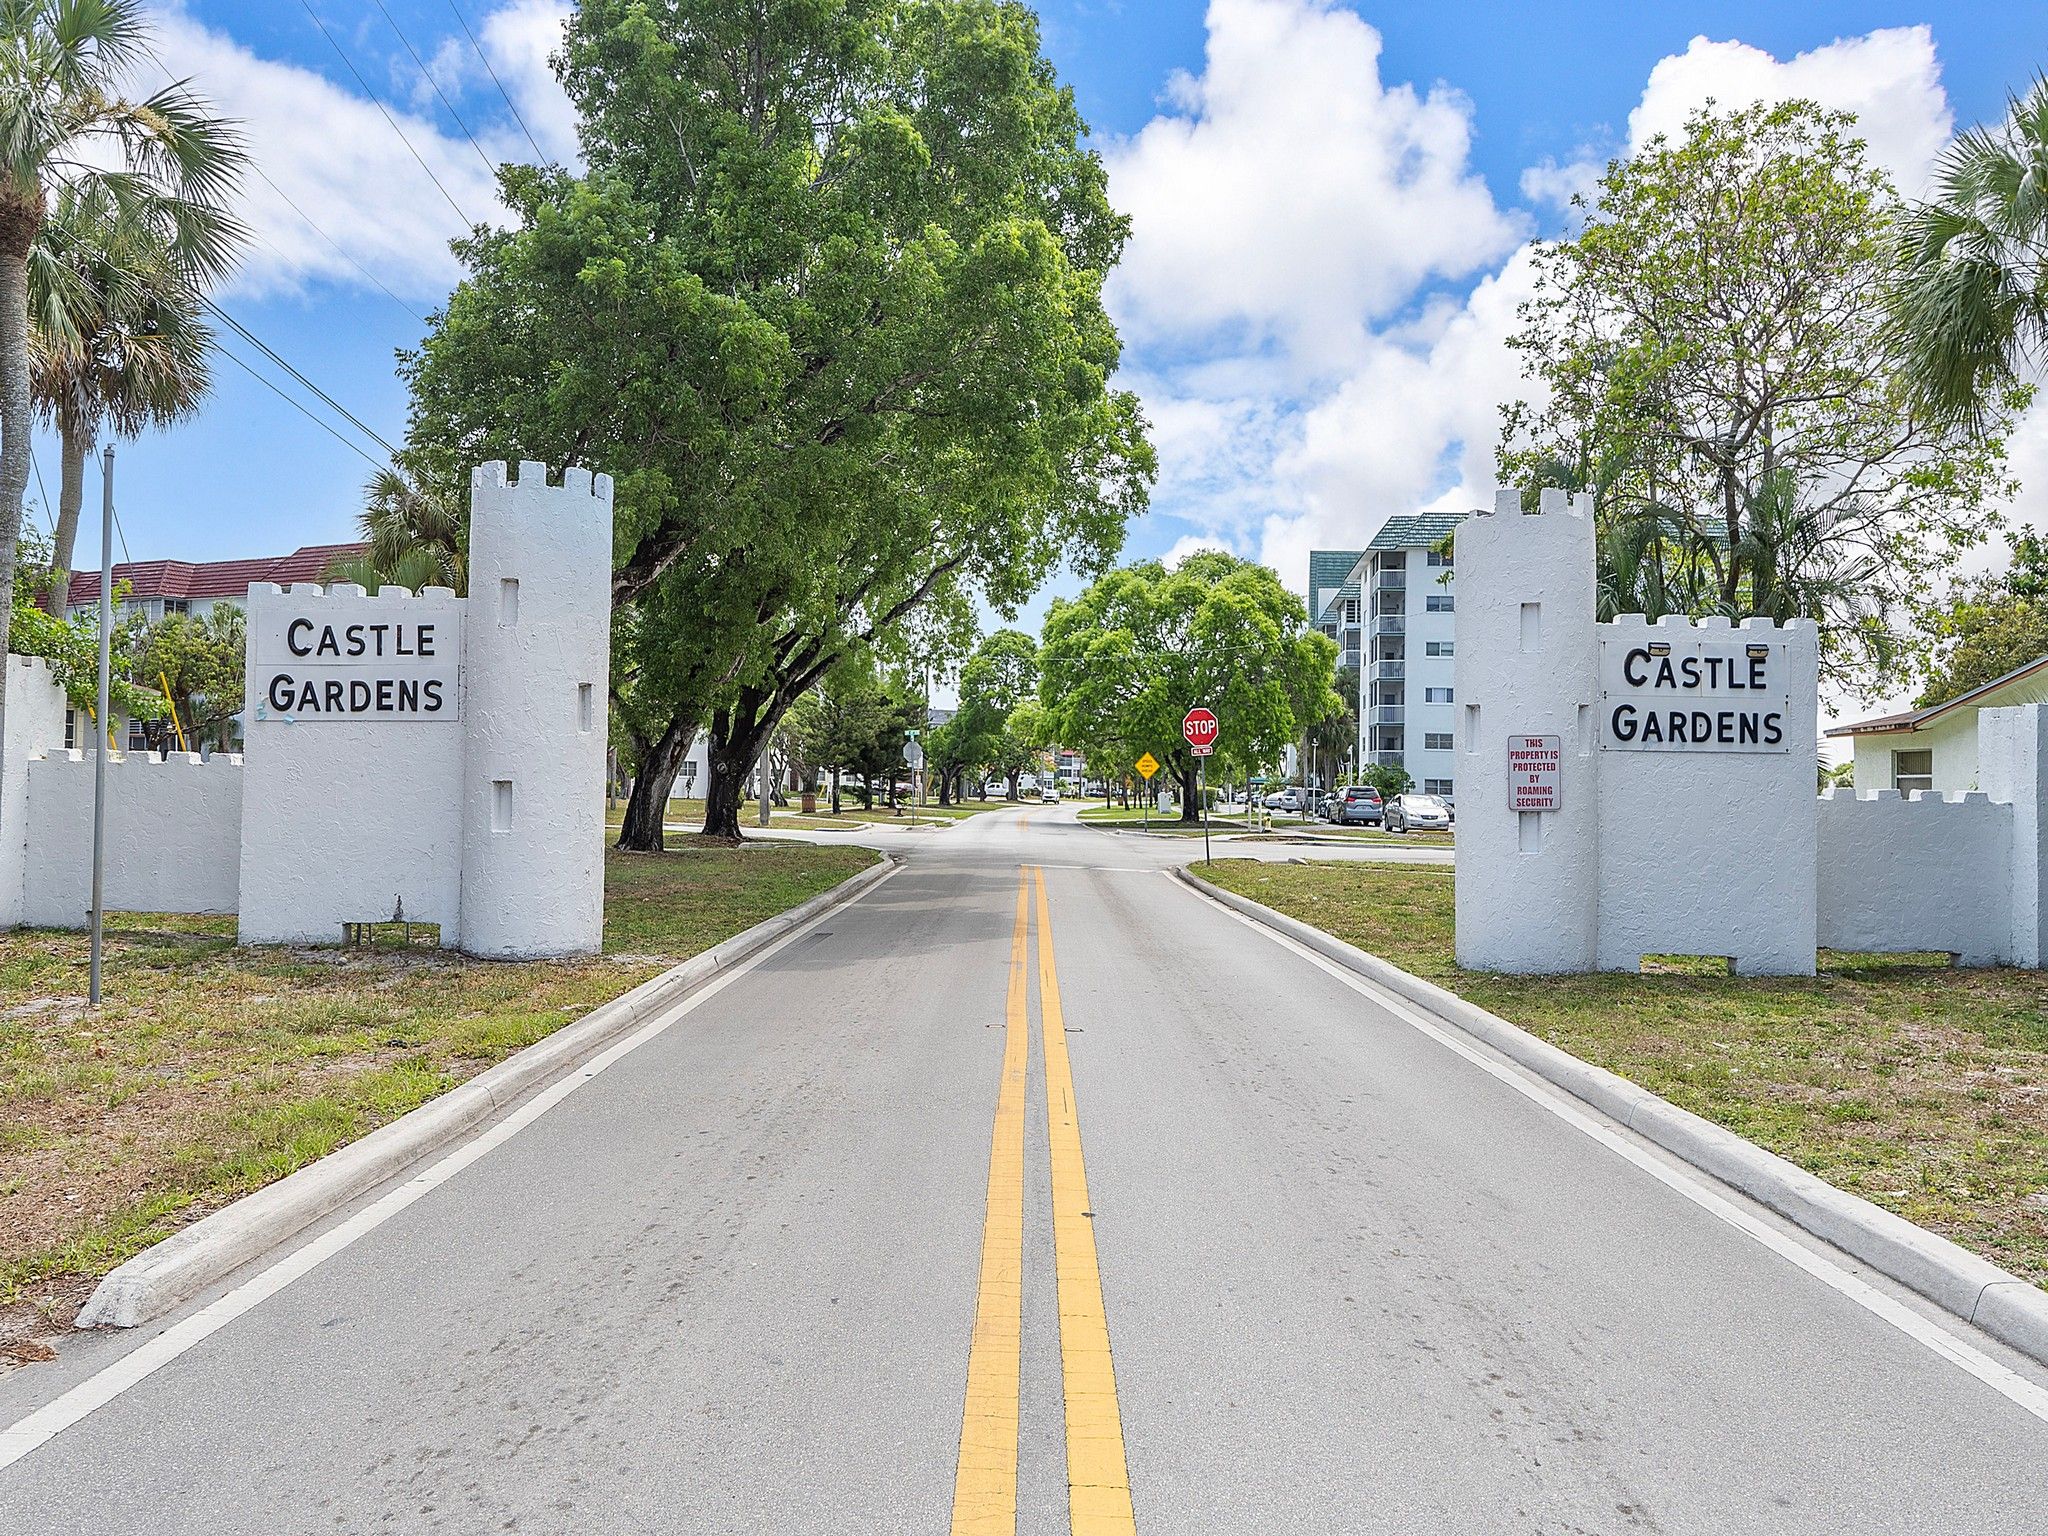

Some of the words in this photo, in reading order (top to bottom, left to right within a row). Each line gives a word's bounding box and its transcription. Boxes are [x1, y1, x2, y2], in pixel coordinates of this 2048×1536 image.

[287, 617, 435, 657] CASTLE
[1623, 648, 1767, 689] CASTLE
[268, 673, 443, 712] GARDENS
[1186, 720, 1215, 735] STOP
[1611, 704, 1783, 744] GARDENS
[1525, 739, 1543, 748] THIS
[1510, 751, 1549, 760] PROPERTY
[1550, 750, 1559, 760] IS
[1513, 762, 1556, 771] PROTECTED
[1529, 775, 1540, 783] BY
[1517, 786, 1553, 795] ROAMING
[1516, 798, 1554, 807] SECURITY
